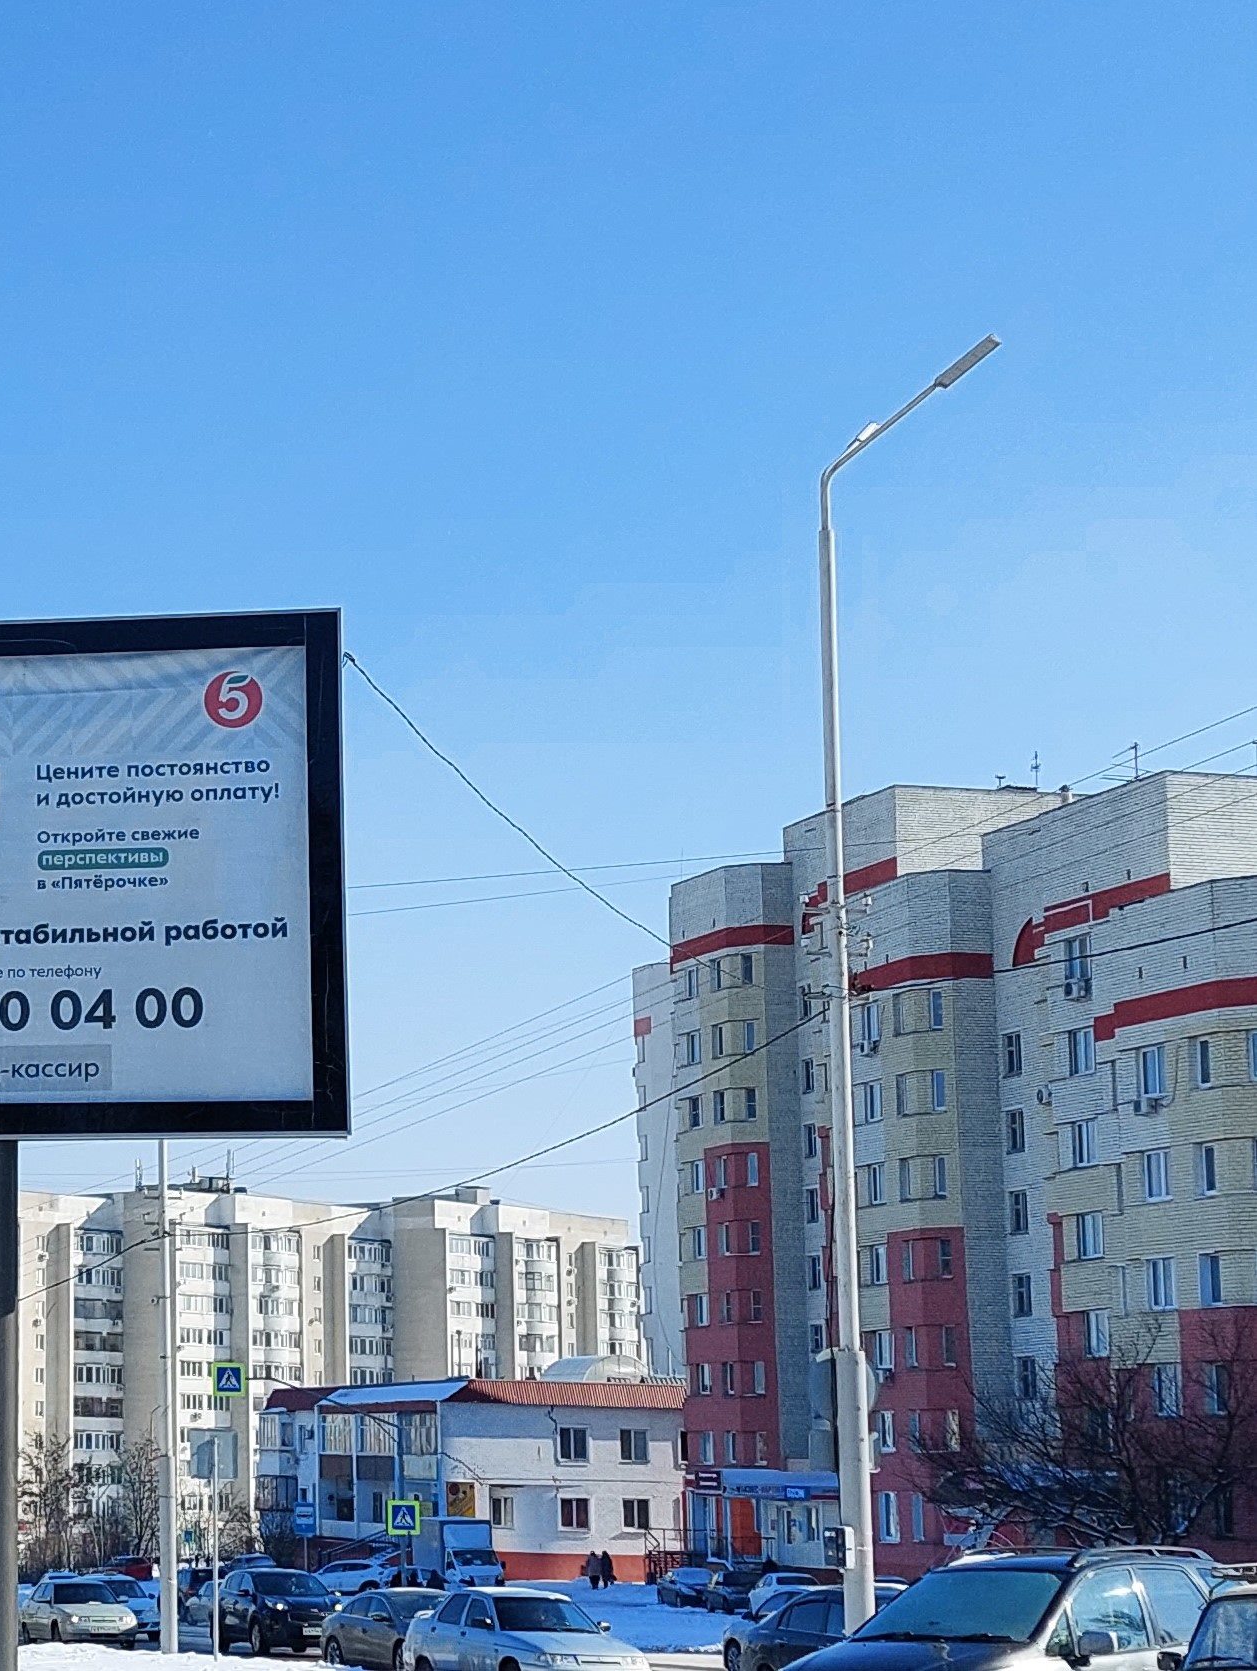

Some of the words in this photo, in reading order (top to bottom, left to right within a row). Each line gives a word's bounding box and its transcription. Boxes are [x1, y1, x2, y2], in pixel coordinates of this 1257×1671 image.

[36, 763, 120, 783] Цените
[127, 759, 271, 778] постоянство
[36, 792, 50, 806] и
[56, 786, 184, 808] достойную
[190, 782, 280, 804] оплату!
[37, 828, 127, 846] Откройте
[131, 827, 200, 841] свежие
[41, 851, 164, 868] перспективы
[37, 879, 47, 890] в
[51, 874, 169, 891] «Пятёрочке»
[165, 917, 288, 946] работой
[7, 966, 26, 979] по
[29, 965, 102, 980] телефону
[50, 988, 116, 1030] 04
[135, 987, 203, 1029] 00
